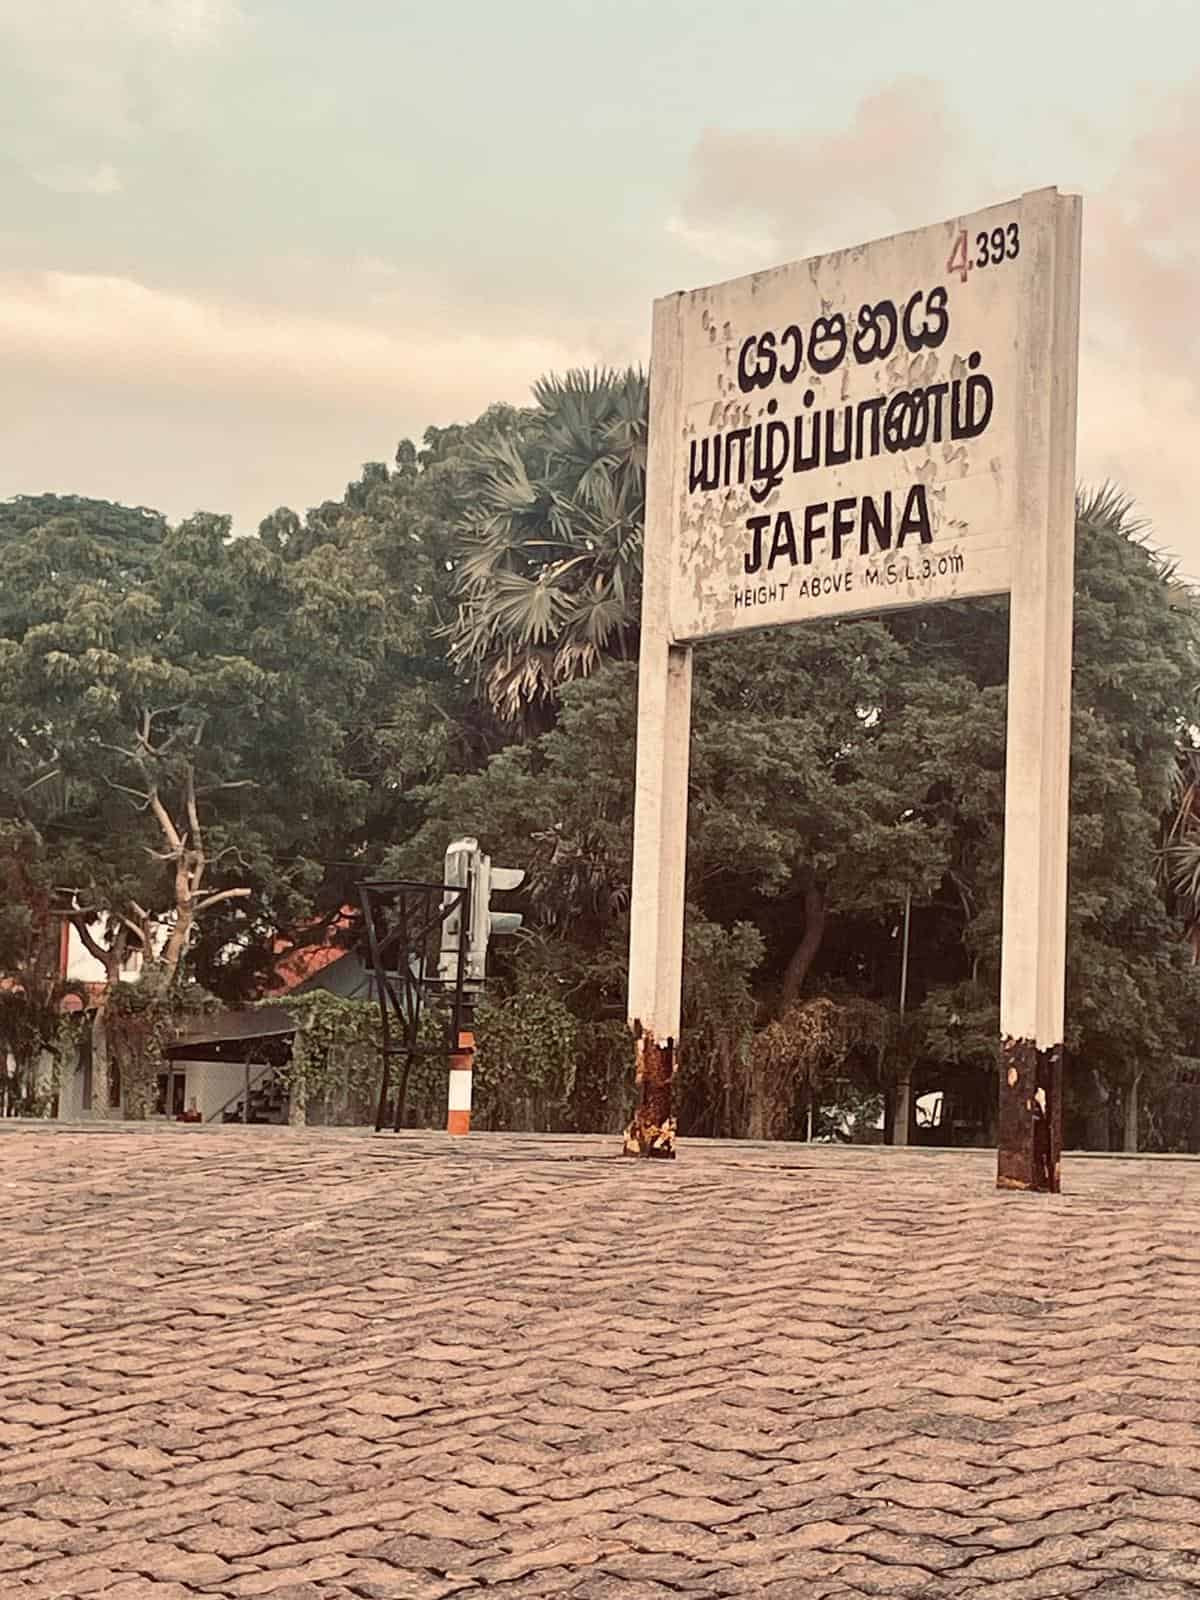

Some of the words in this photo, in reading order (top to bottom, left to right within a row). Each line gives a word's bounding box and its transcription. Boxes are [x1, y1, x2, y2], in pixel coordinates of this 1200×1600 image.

[737, 286, 949, 394] යාපනය
[689, 351, 994, 503] யாழ்ப்பாணம்
[744, 484, 933, 574] JAFFNA
[734, 583, 788, 609] HEIGHT
[800, 572, 853, 598] ABOVE
